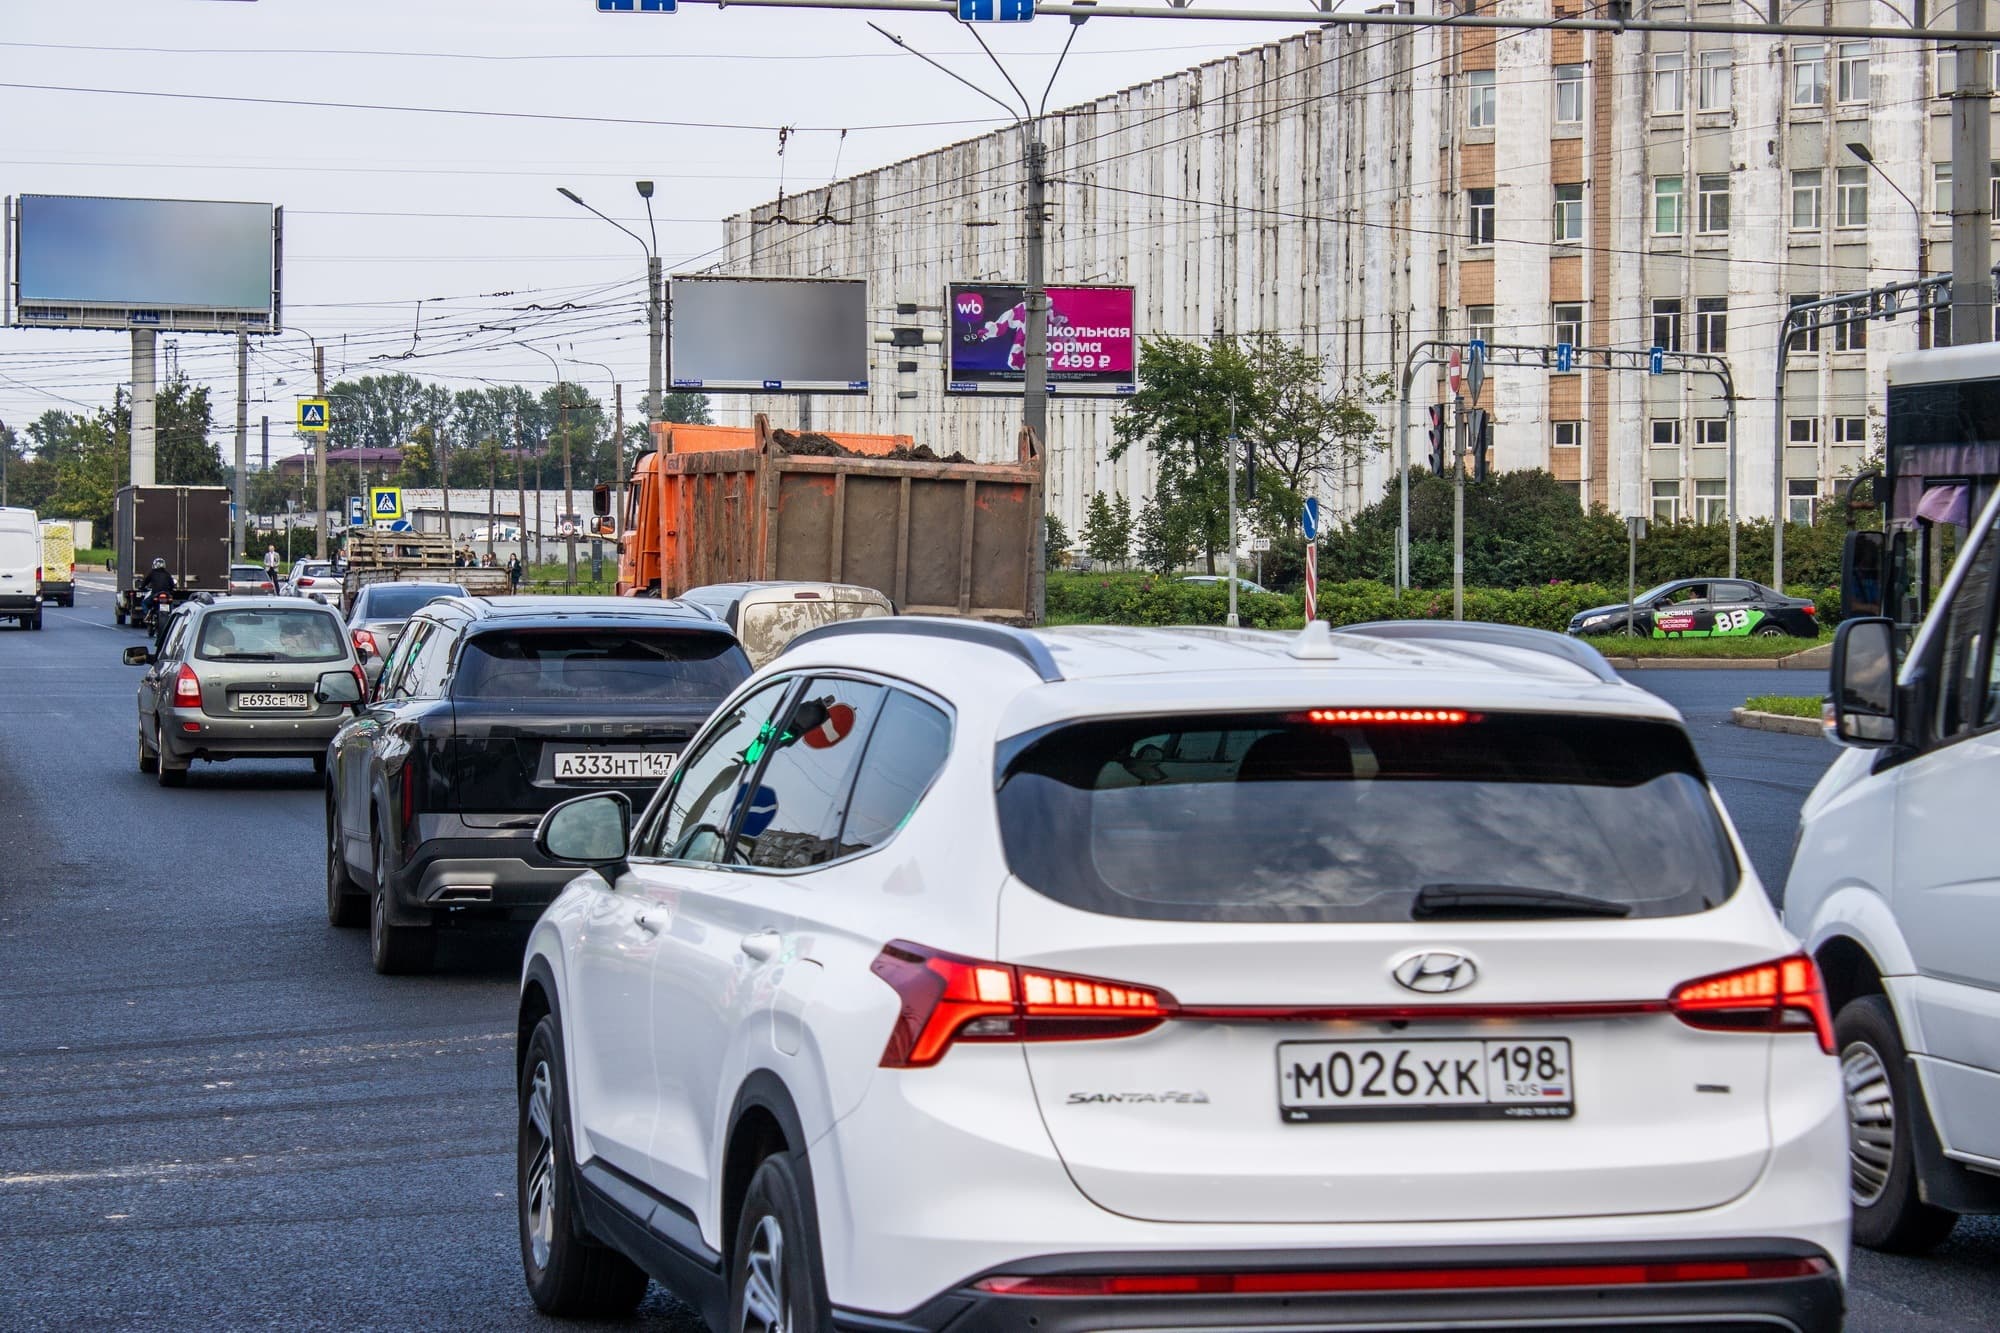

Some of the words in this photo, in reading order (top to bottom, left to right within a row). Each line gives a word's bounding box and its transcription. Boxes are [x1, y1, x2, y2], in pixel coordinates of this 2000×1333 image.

[958, 300, 982, 314] wb
[1046, 358, 1055, 368] т
[1057, 355, 1095, 368] 499
[242, 695, 286, 706] Е693СЕ
[288, 694, 304, 703] 178
[562, 756, 639, 775] А333НТ
[644, 754, 673, 769] 147
[1294, 1050, 1480, 1098] М026ХК
[1491, 1046, 1556, 1081] 198
[1506, 1083, 1540, 1096] RUS
